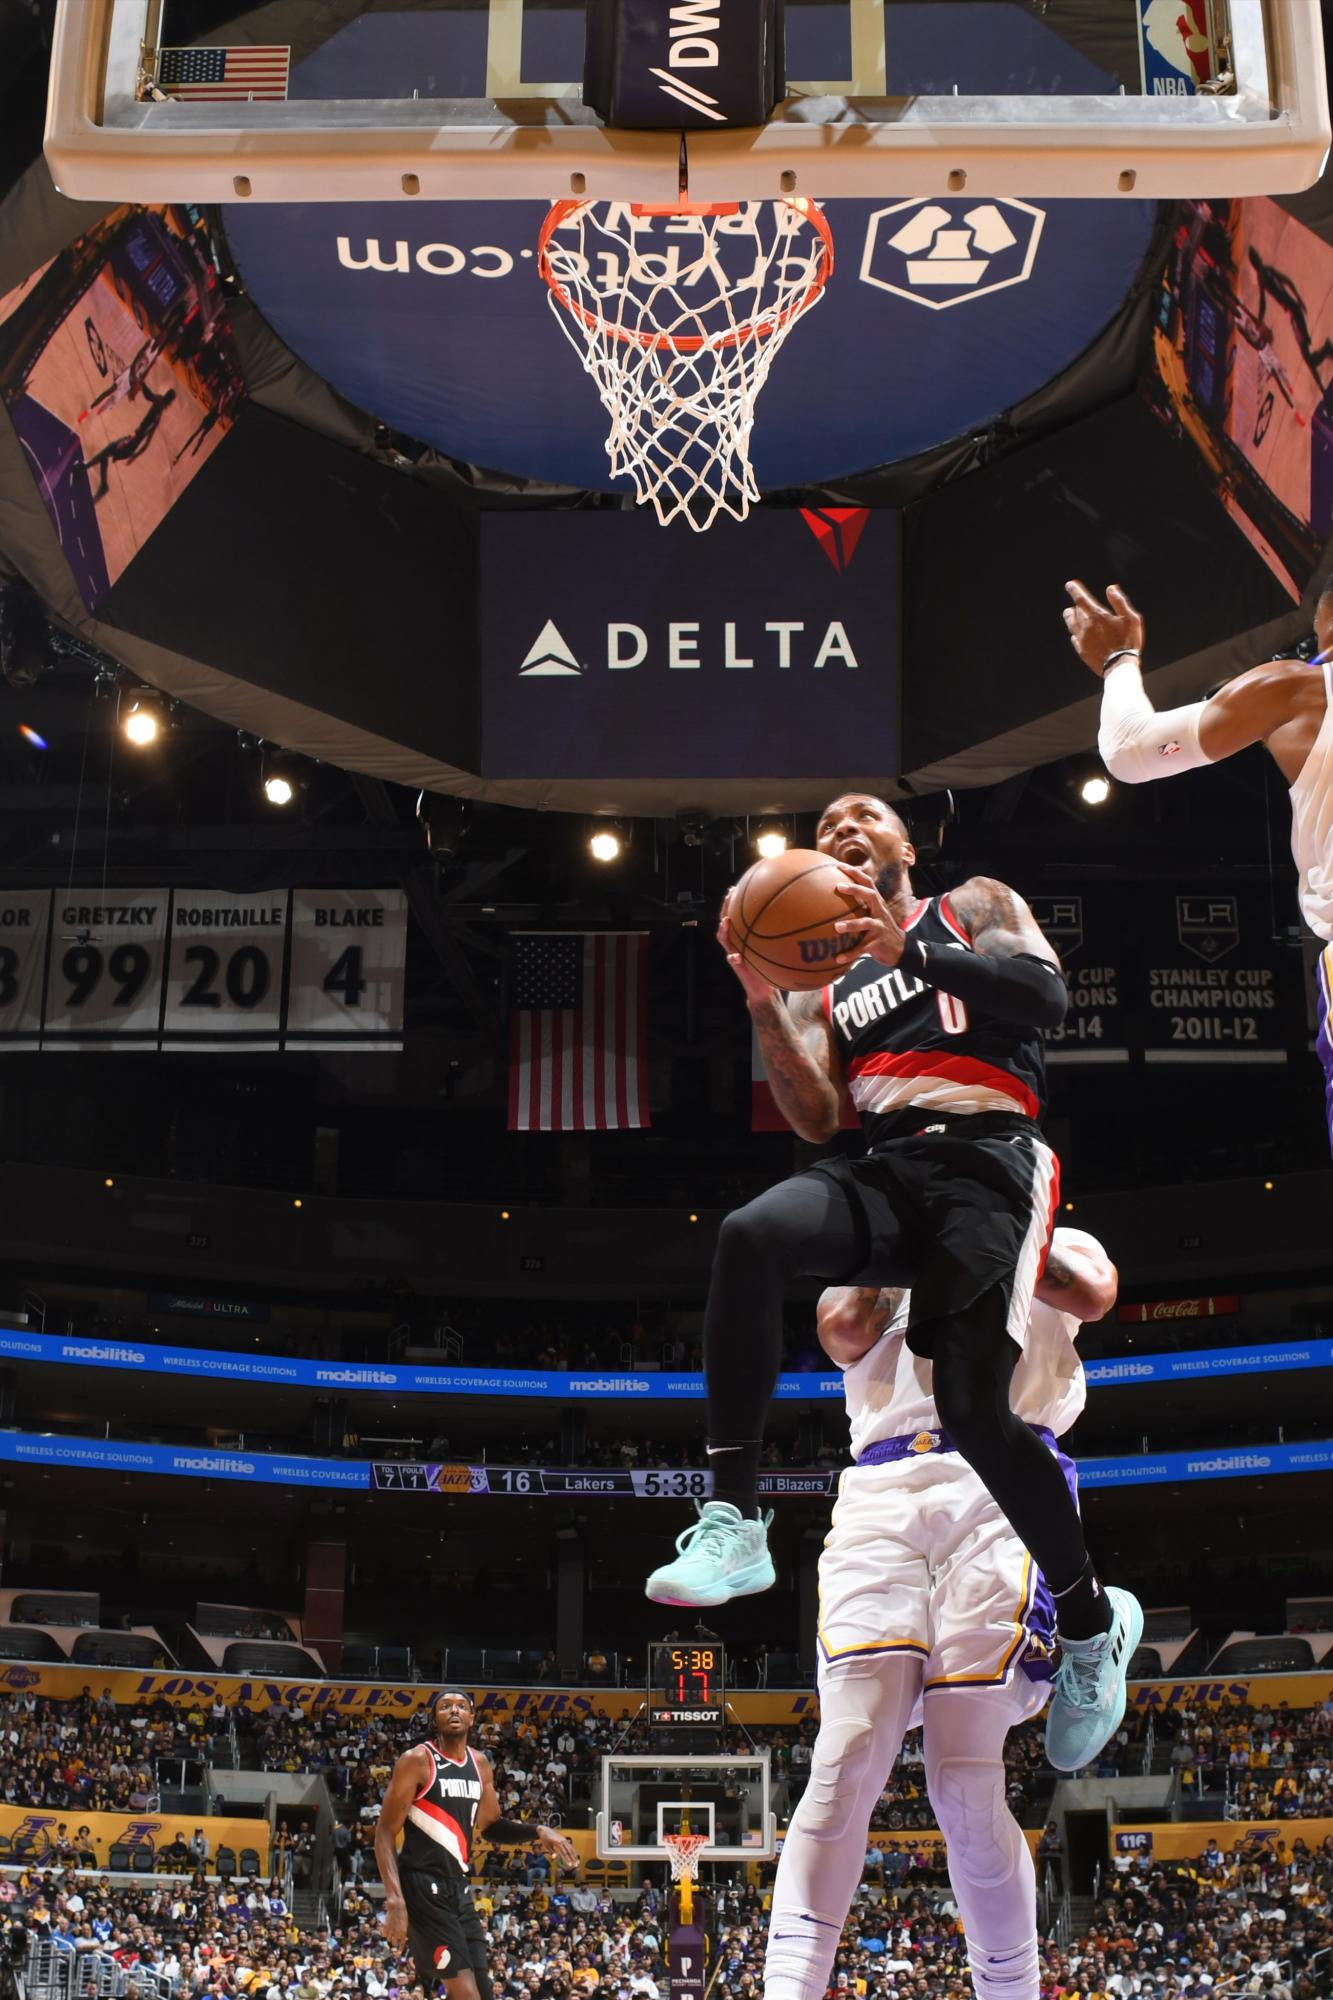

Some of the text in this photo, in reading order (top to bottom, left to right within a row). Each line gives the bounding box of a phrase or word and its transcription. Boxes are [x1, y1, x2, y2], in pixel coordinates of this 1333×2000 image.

[1153, 77, 1188, 96] NBA
[336, 236, 824, 289] crypto.com
[607, 621, 859, 669] DELTA
[62, 907, 157, 926] GRETZKY
[176, 908, 281, 927] ROBITAILLE
[314, 908, 385, 927] BLAKE
[1182, 903, 1233, 923] LA
[62, 944, 150, 1007] 99
[179, 945, 270, 1008] 20
[323, 945, 366, 1007] 4
[1078, 968, 1117, 985] CUP
[1149, 969, 1273, 986] STANLEY CUP
[1151, 990, 1275, 1008] CHAMPIONS
[1171, 1017, 1259, 1040] 2011-12
[213, 1303, 249, 1315] ULTRA
[0, 1340, 42, 1353] OLUTIONS
[62, 1346, 145, 1363] mobilitie
[163, 1356, 297, 1377] WIRELESS COVERAGE SOLUTIONS
[1171, 1352, 1311, 1371] WIRELESS COVERAGE SOLUTIONS
[316, 1369, 397, 1384] mobilitie
[415, 1376, 548, 1389] WIRELESS COVERAGE SOLUTIONS
[569, 1379, 650, 1392] mobilitie
[667, 1382, 704, 1391] WIRELESS
[16, 1445, 153, 1464] WIRELESS COVERAGE SOLUTIONS
[1289, 1453, 1328, 1463] WIRELESS
[173, 1457, 255, 1474] mobilitie
[402, 1467, 423, 1475] FOULS
[1121, 1466, 1167, 1477] SOLUTIONS
[1188, 1455, 1271, 1473] mobilitie
[273, 1466, 309, 1478] WIRELESS
[311, 1470, 359, 1481] COVERAGE
[385, 1474, 394, 1488] 7
[411, 1475, 418, 1488] 1
[502, 1472, 531, 1491] 16
[1078, 1469, 1119, 1480] OVERAGE
[565, 1478, 615, 1490] Lakers
[645, 1473, 706, 1496] 5:38
[758, 1478, 824, 1490] ail Blazers
[672, 1651, 714, 1670] 5:38
[136, 1676, 595, 1712] LOS ANGELES LKERS
[679, 1672, 708, 1703] 17
[1135, 1682, 1251, 1705] KERS
[671, 1711, 719, 1722] TISSOT
